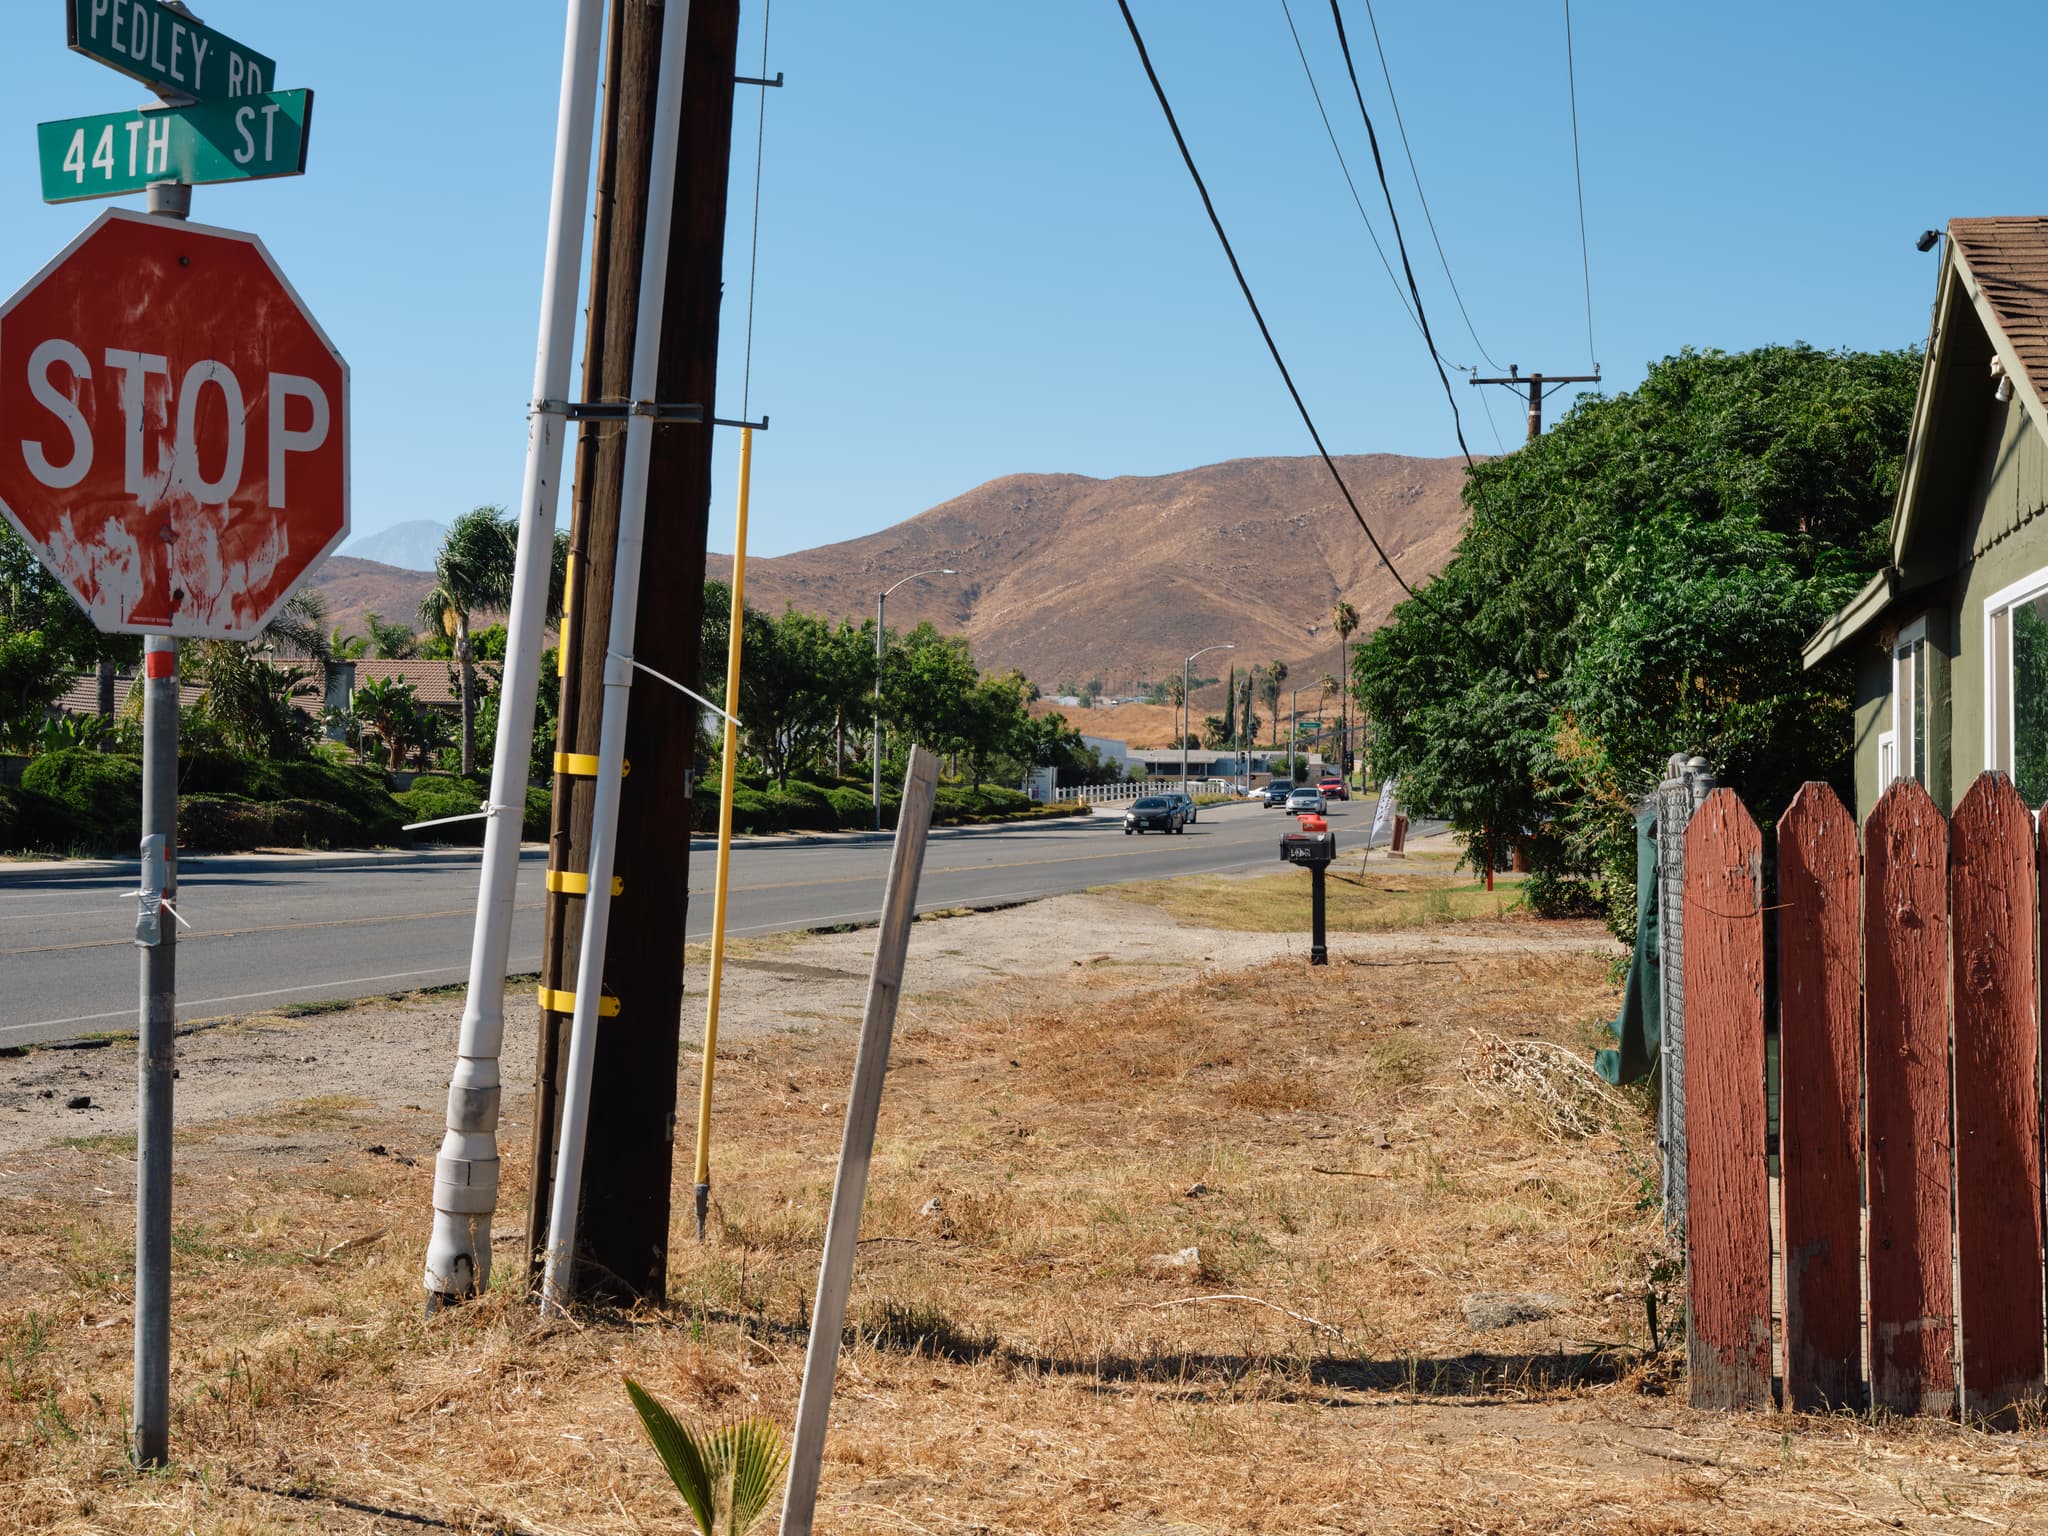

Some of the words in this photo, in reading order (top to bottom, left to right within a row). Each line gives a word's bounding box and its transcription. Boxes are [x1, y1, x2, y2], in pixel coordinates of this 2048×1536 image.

[91, 0, 208, 90] PEDLEY
[228, 51, 262, 97] RD
[63, 117, 170, 183] 44TH
[234, 103, 280, 164] ST
[21, 338, 330, 509] STOP
